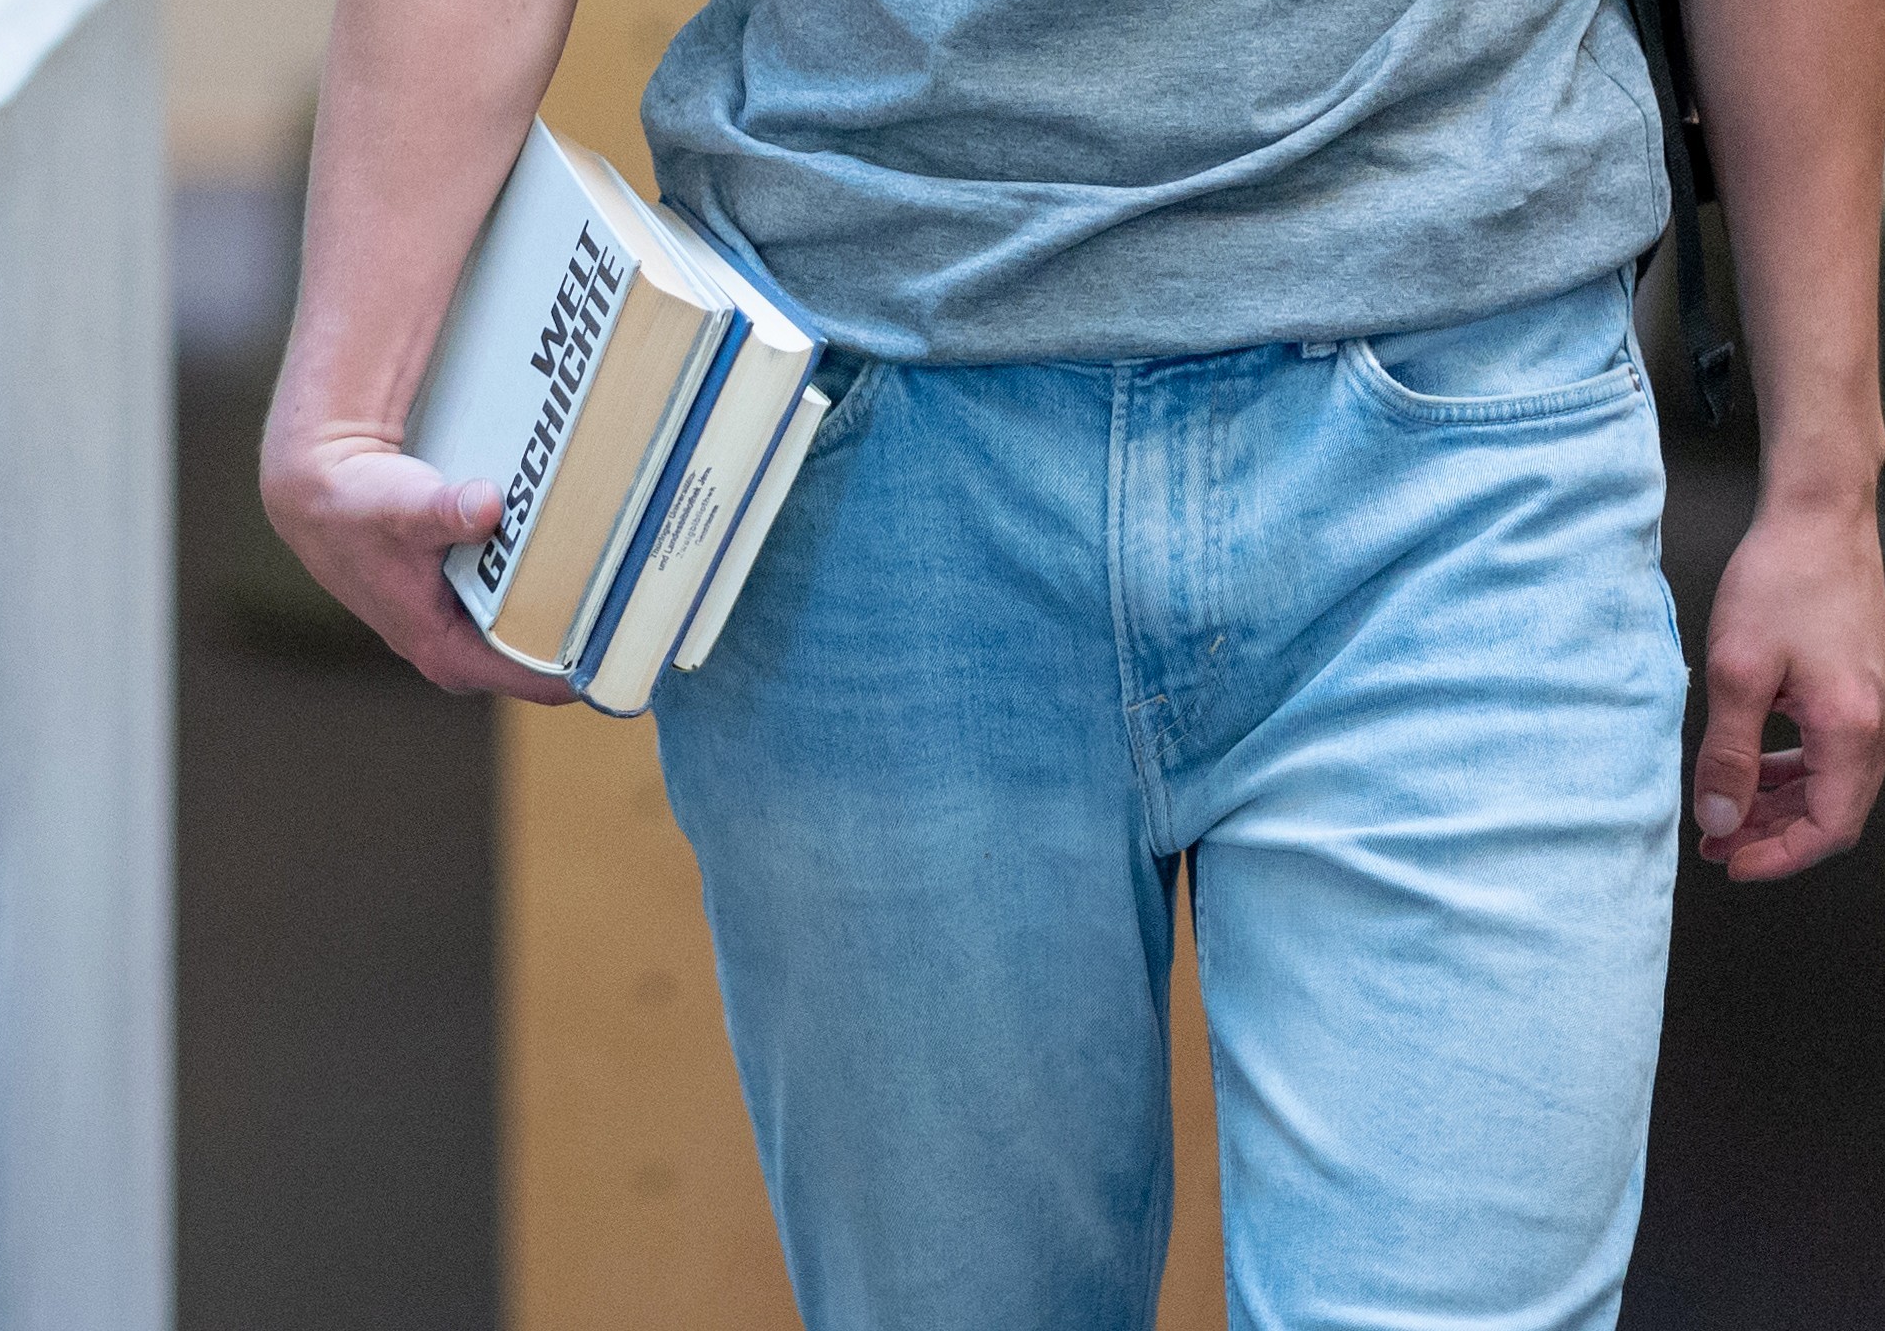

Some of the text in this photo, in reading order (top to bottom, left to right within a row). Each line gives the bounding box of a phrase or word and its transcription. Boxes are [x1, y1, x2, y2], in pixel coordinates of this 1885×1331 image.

[530, 220, 601, 378] WELT
[476, 245, 624, 594] GESCHICHTE
[658, 554, 669, 571] und
